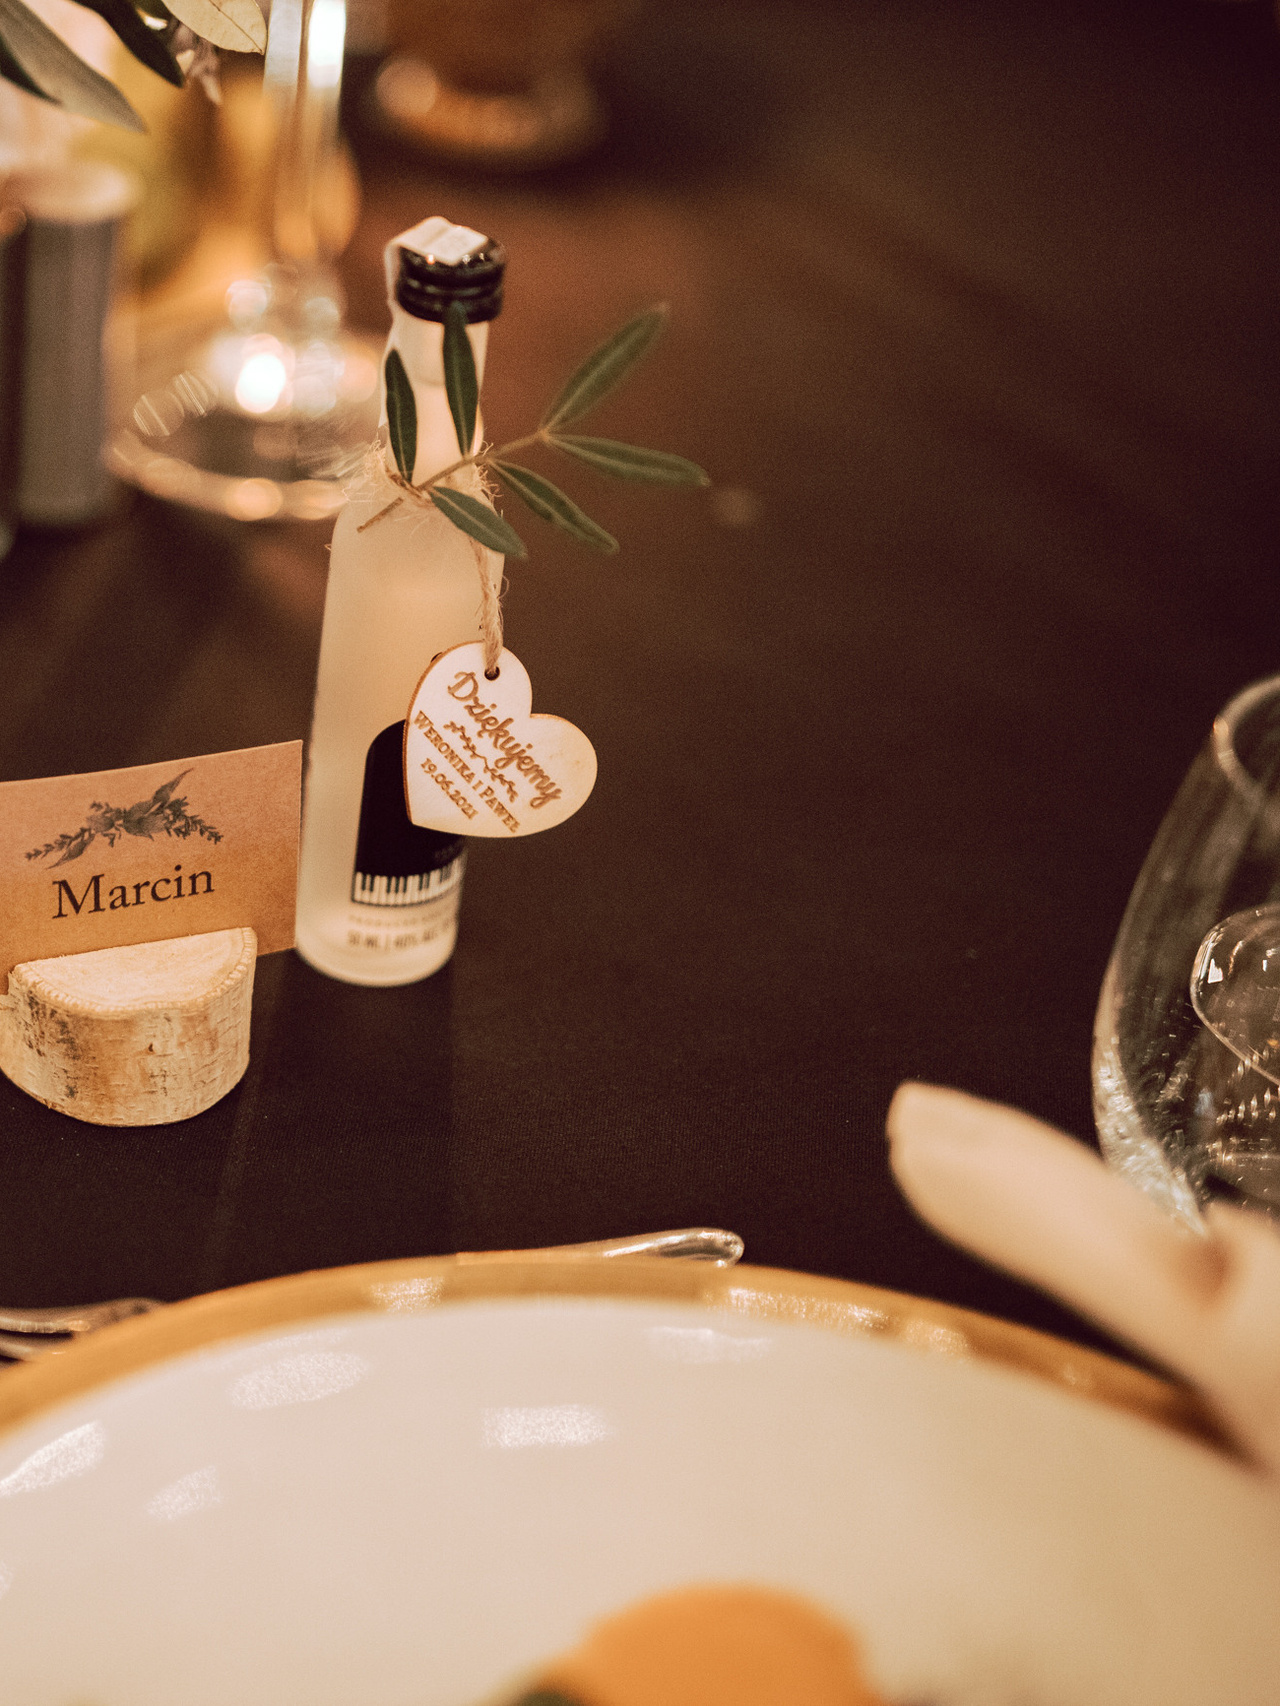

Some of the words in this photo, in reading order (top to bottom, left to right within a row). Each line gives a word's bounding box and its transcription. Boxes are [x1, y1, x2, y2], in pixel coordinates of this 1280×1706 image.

[447, 671, 562, 809] Dziękujemy
[420, 758, 479, 820] 19.06.2021
[52, 864, 215, 919] Marcin
